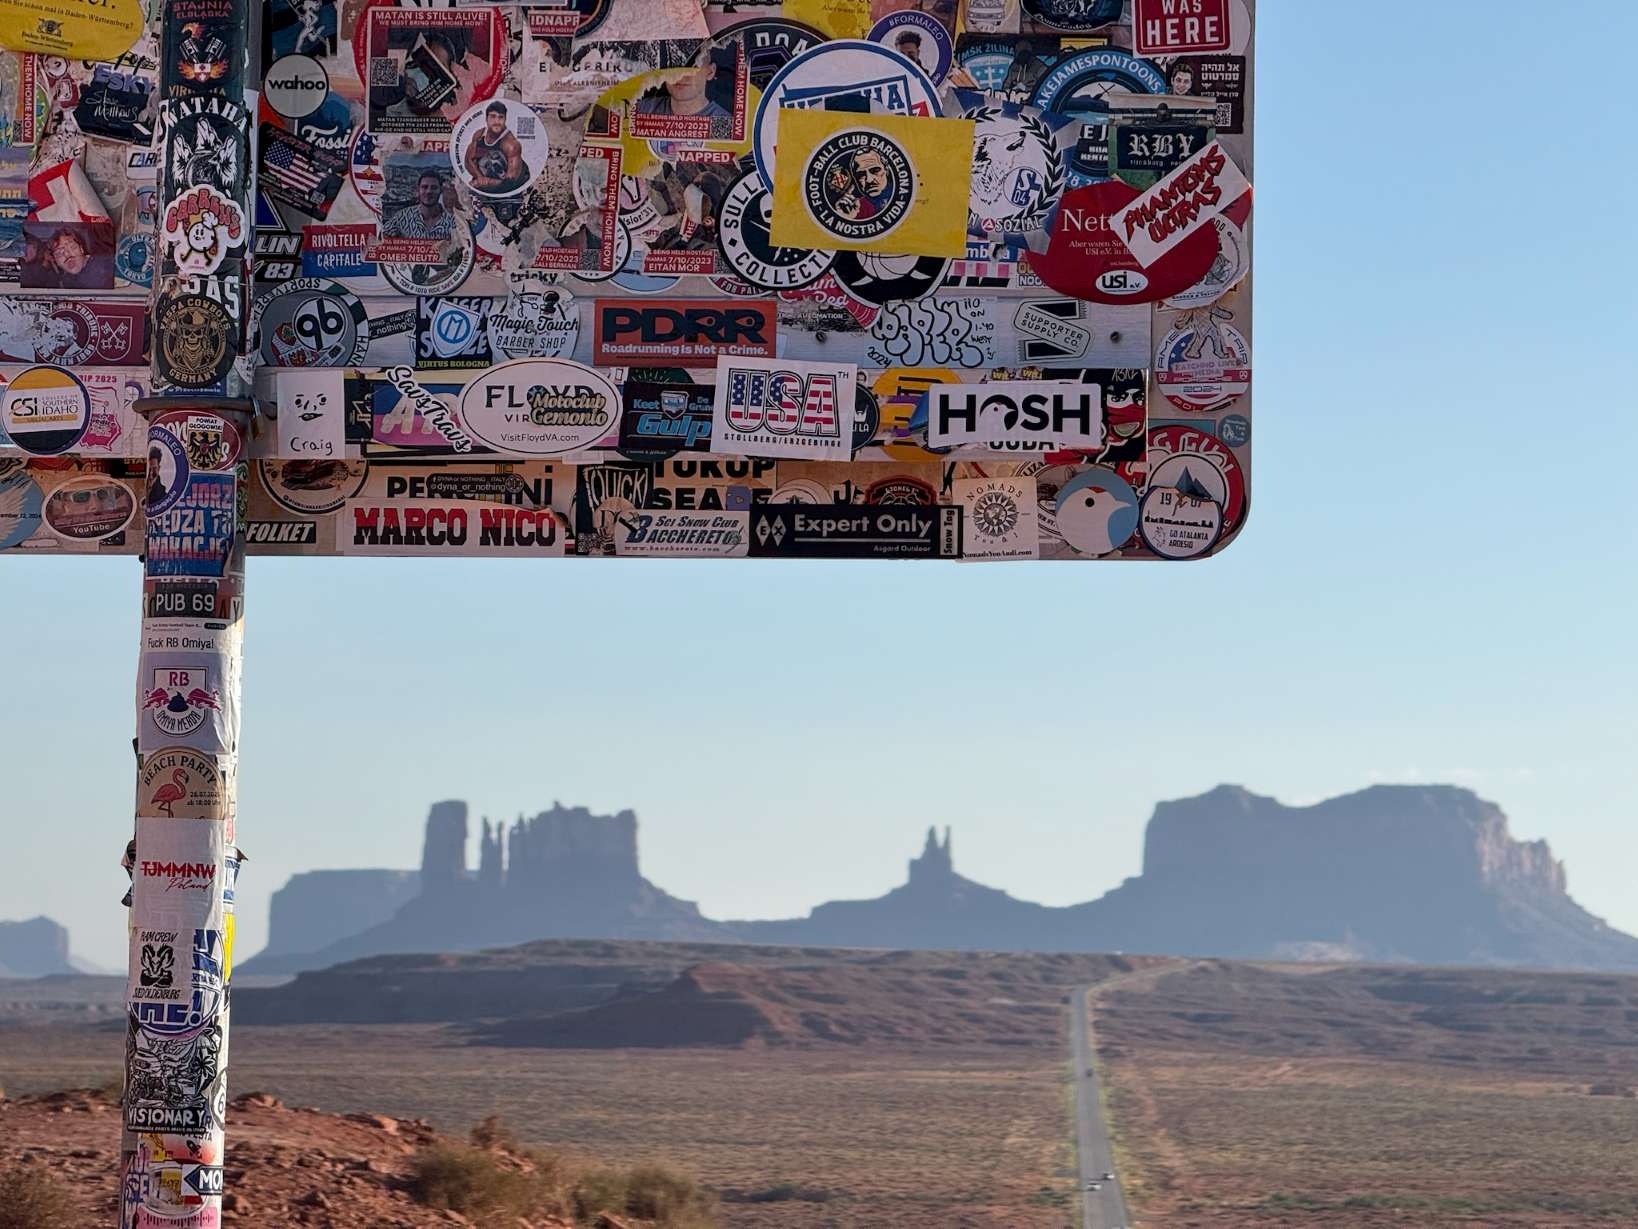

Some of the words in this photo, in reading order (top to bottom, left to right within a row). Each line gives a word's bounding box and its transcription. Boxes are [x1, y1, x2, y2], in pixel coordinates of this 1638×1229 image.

[375, 11, 412, 21] MATAN
[414, 11, 423, 21] IS
[425, 11, 453, 21] STILL
[455, 11, 488, 21] ALIVE!
[888, 14, 944, 42] #FORMALEO
[1146, 16, 1219, 46] HERE
[24, 55, 33, 81] THEM
[268, 74, 326, 91] wahoo
[24, 84, 33, 114] HOME
[24, 117, 33, 138] NOW
[665, 121, 710, 131] 7/10/2023
[733, 112, 744, 136] NOW
[636, 130, 668, 139] MATAN
[668, 131, 709, 139] ANGREST
[837, 134, 869, 149] CLUB
[611, 151, 621, 179] BRING
[608, 182, 619, 211] THEM
[820, 209, 834, 227] LA
[834, 220, 884, 235] NOSTRA
[882, 200, 905, 224] VIDA
[604, 212, 614, 246] HOME
[311, 233, 367, 248] RIVOLTELLA
[1068, 240, 1088, 248] Aber
[1111, 240, 1123, 248] Sie
[317, 253, 362, 270] CAPITALE
[379, 253, 407, 262] OMER
[536, 253, 579, 263] 7/10/2023
[602, 249, 612, 267] NOW
[668, 256, 712, 265] 7/10/2023
[735, 248, 831, 286] COLLECTI
[264, 262, 295, 279] 83
[648, 263, 677, 272] EITAN
[677, 263, 701, 272] MOR
[159, 300, 186, 332] VESPA
[186, 297, 232, 332] COWBOYS
[490, 313, 534, 333] Magic
[536, 313, 579, 331] Touch
[601, 307, 768, 344] PDRR
[1020, 319, 1059, 338] SUPPLY
[1023, 311, 1084, 340] SUPPORTER
[495, 336, 535, 349] BARBER
[539, 335, 567, 349] SHOP
[601, 343, 677, 355] Roadrunning
[678, 343, 691, 354] is
[693, 344, 716, 355] Not
[717, 345, 726, 355] a
[729, 344, 769, 356] Crime.
[417, 360, 449, 368] VIRTUS
[449, 360, 490, 368] BOLOGNA
[167, 367, 219, 385] GERMANY
[41, 404, 79, 416] IDAHO
[725, 368, 841, 438] USA
[195, 417, 218, 425] POWIAT
[636, 413, 713, 447] Gulp
[289, 436, 334, 456] Craig
[500, 432, 580, 444] VisitFloydVA.com
[966, 482, 1025, 502] NOMADS
[1160, 492, 1173, 506] 19
[73, 524, 111, 535] YouTube
[246, 522, 315, 542] FOLKET
[353, 507, 468, 546] MARCO
[479, 508, 556, 547] NICO
[794, 514, 869, 537] Expert
[876, 514, 932, 538] Only
[1179, 530, 1209, 541] ATALANTA
[944, 529, 955, 555] Snow
[156, 593, 186, 612] PUB
[192, 593, 215, 612] 69
[147, 637, 165, 649] Fuck
[166, 636, 179, 648] RB
[181, 636, 215, 651] Omiya!
[168, 671, 191, 687] RB
[143, 755, 177, 787] BEACH
[180, 755, 218, 784] PARTY
[127, 1106, 207, 1127] VISIONARY
